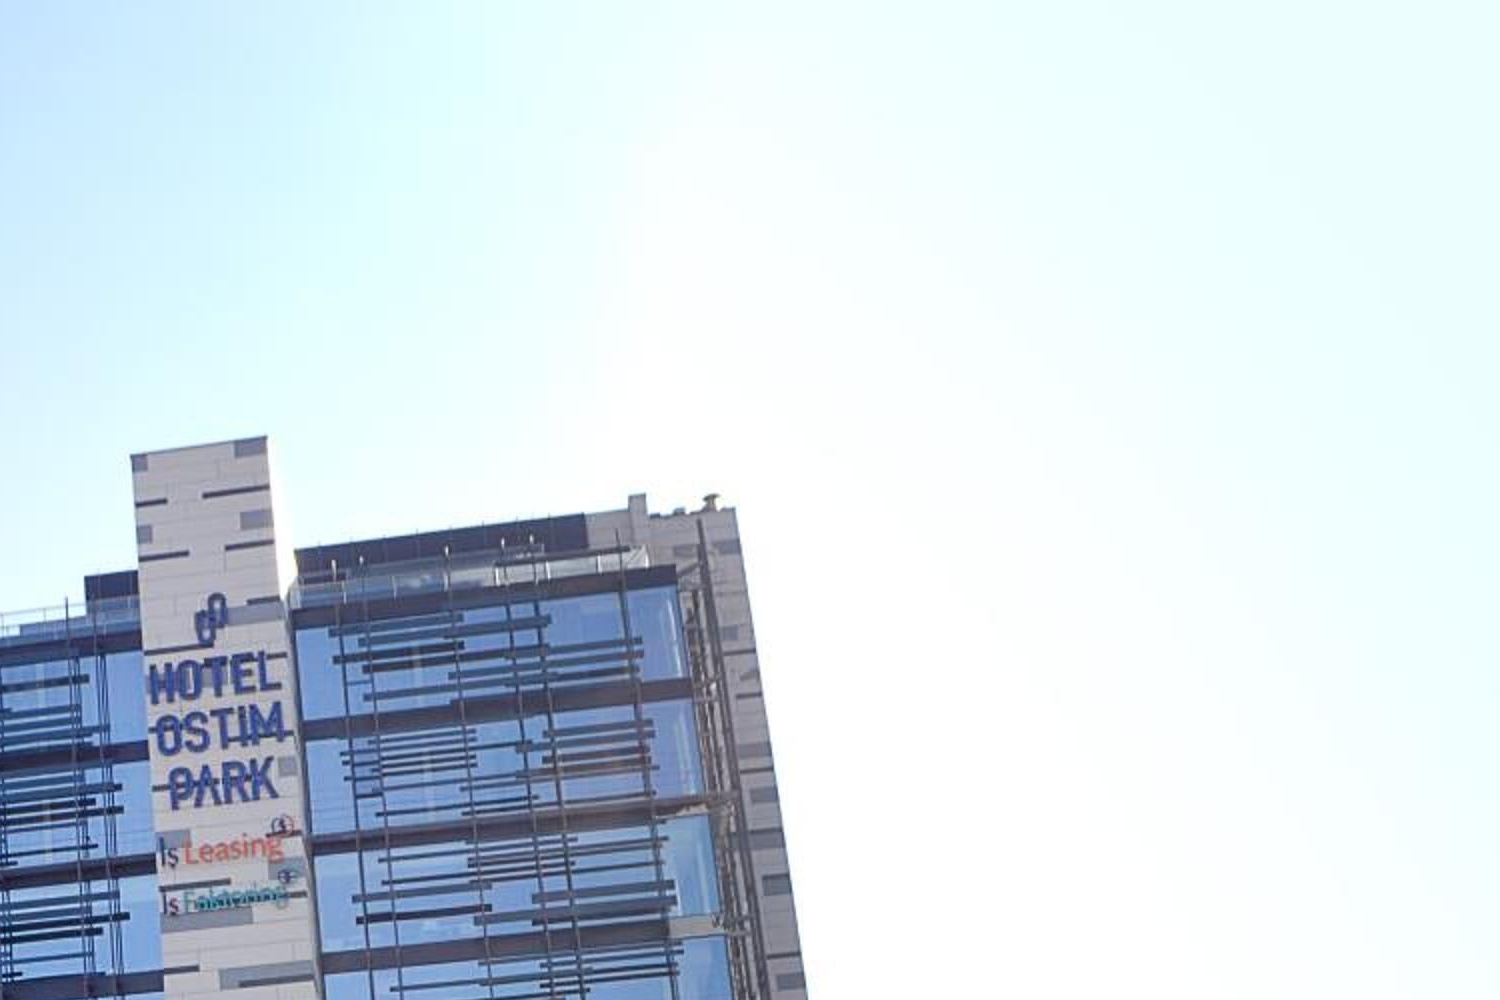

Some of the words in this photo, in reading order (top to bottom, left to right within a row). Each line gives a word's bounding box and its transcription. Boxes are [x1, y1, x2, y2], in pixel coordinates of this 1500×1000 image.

[150, 650, 283, 705] HOTEL
[168, 755, 280, 810] PARK
[184, 833, 285, 865] Leasing
